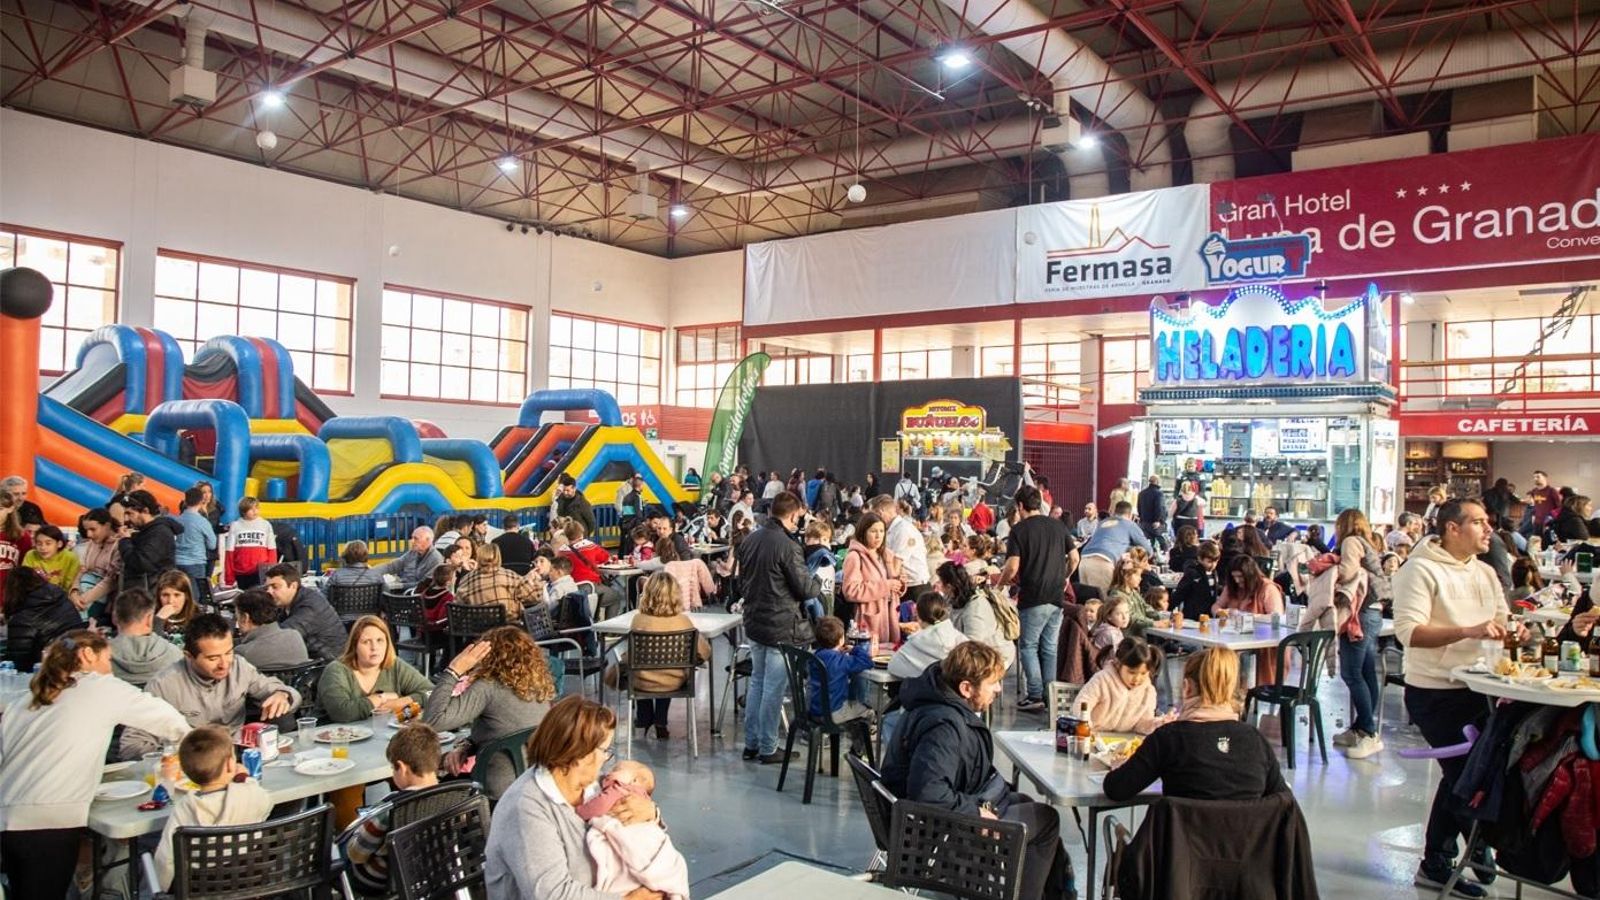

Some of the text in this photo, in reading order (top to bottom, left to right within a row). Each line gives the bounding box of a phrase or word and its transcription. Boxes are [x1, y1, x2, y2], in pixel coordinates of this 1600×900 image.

[1218, 188, 1351, 223] Gran Hotel
[1338, 213, 1396, 251] de
[1412, 187, 1600, 245] Granad
[1546, 235, 1600, 249] Conve
[1046, 256, 1172, 285] Fermasa
[1157, 321, 1356, 381] HELADERIA
[1457, 414, 1589, 433] CAFETERÍA
[238, 532, 265, 540] STREET
